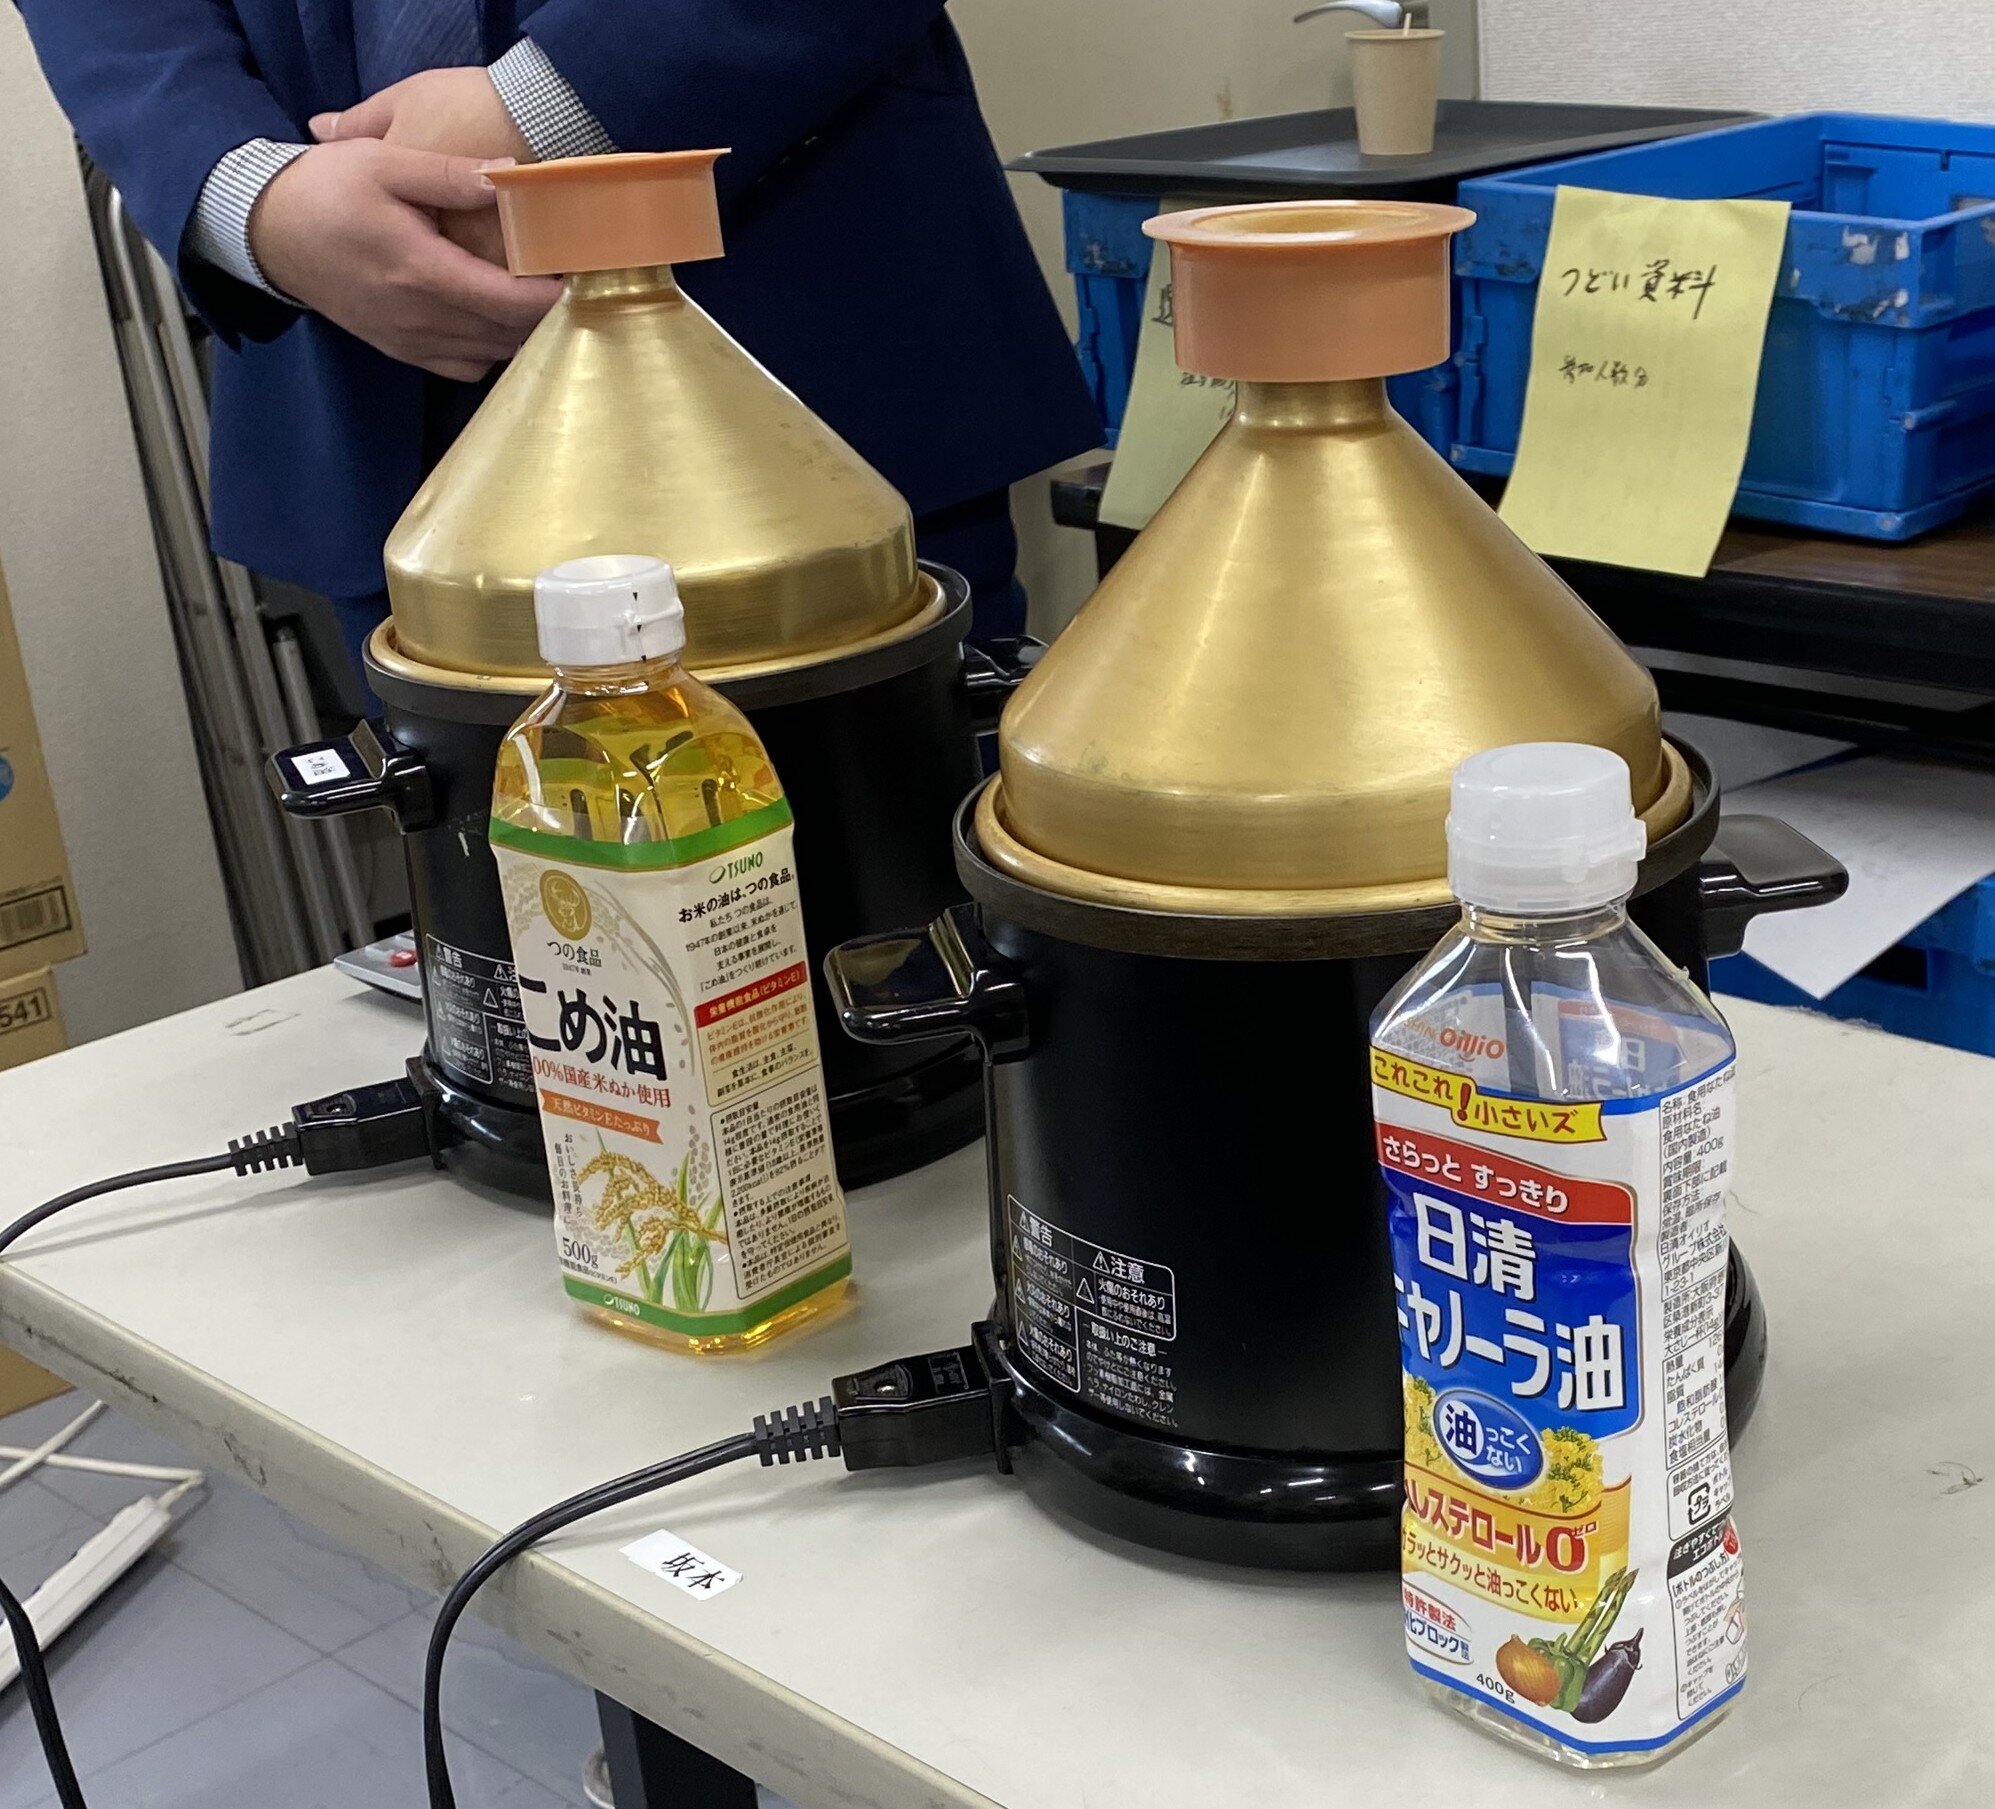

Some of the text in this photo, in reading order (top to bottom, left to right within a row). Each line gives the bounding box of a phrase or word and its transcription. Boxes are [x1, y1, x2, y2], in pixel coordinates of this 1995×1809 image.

[547, 941, 602, 968] つの食品
[518, 974, 667, 1081] こめ油
[552, 1098, 651, 1134] 天然ビタミンEたっぷり
[1475, 1101, 1579, 1135] 小さいズ
[1696, 1136, 1725, 1157] 400g
[1382, 1135, 1569, 1214] さらっと すっきり
[1029, 1215, 1053, 1248] 警告
[1412, 1191, 1537, 1301] 日清
[1660, 1220, 1710, 1256] 日清オイリオ
[562, 1236, 599, 1269] 500g
[1110, 1255, 1145, 1285] 注意
[1664, 1272, 1695, 1297] 1-23-1
[1446, 1403, 1478, 1456] 油
[1485, 1444, 1523, 1473] ない
[1405, 1479, 1586, 1572] レステロール0
[1476, 1672, 1516, 1705] 400g
